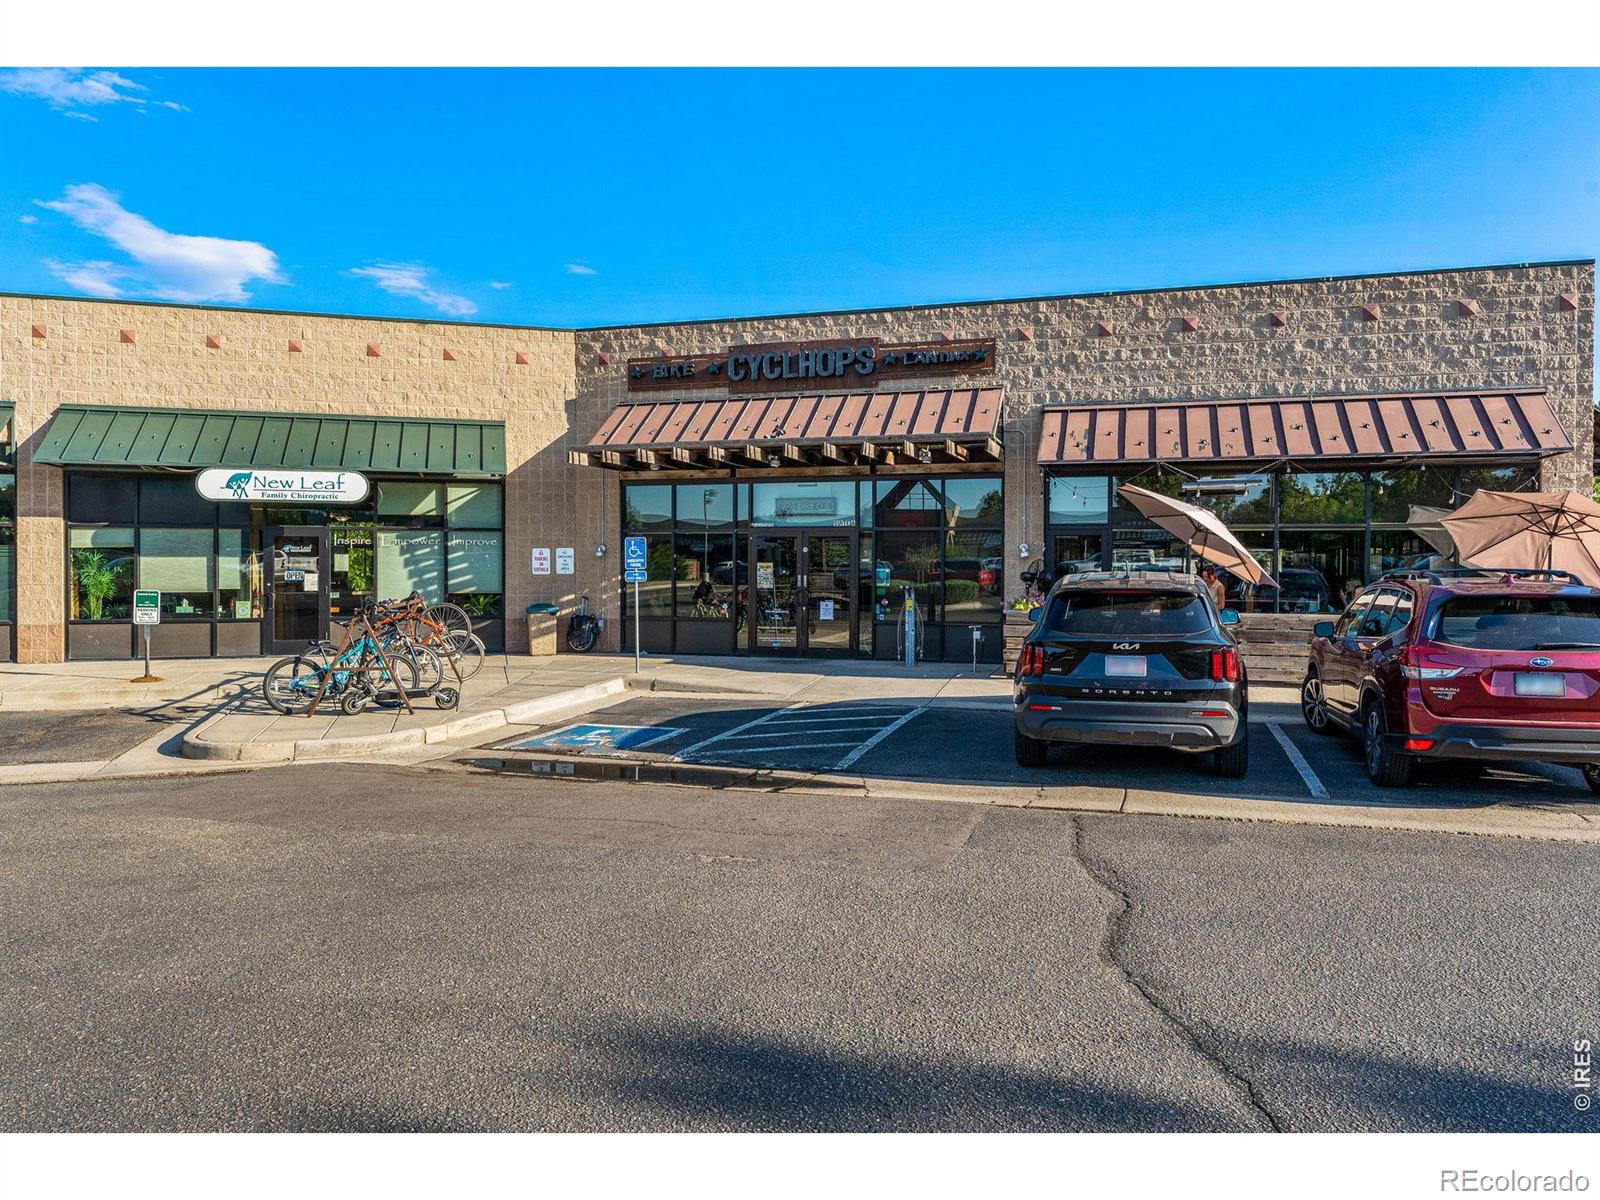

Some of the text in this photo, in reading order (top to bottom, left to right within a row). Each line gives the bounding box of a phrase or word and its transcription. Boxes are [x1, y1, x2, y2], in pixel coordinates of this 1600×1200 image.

[652, 363, 695, 378] BIKE
[727, 346, 875, 382] CYCLHOPS
[253, 473, 346, 490] New Leaf
[261, 492, 339, 501] Family Chiropractic
[333, 533, 372, 549] Inspire
[381, 533, 441, 549] Empower
[452, 534, 497, 549] Improve
[286, 571, 305, 579] OPEN
[1112, 642, 1140, 650] KIA
[1081, 688, 1172, 696] SORENTO
